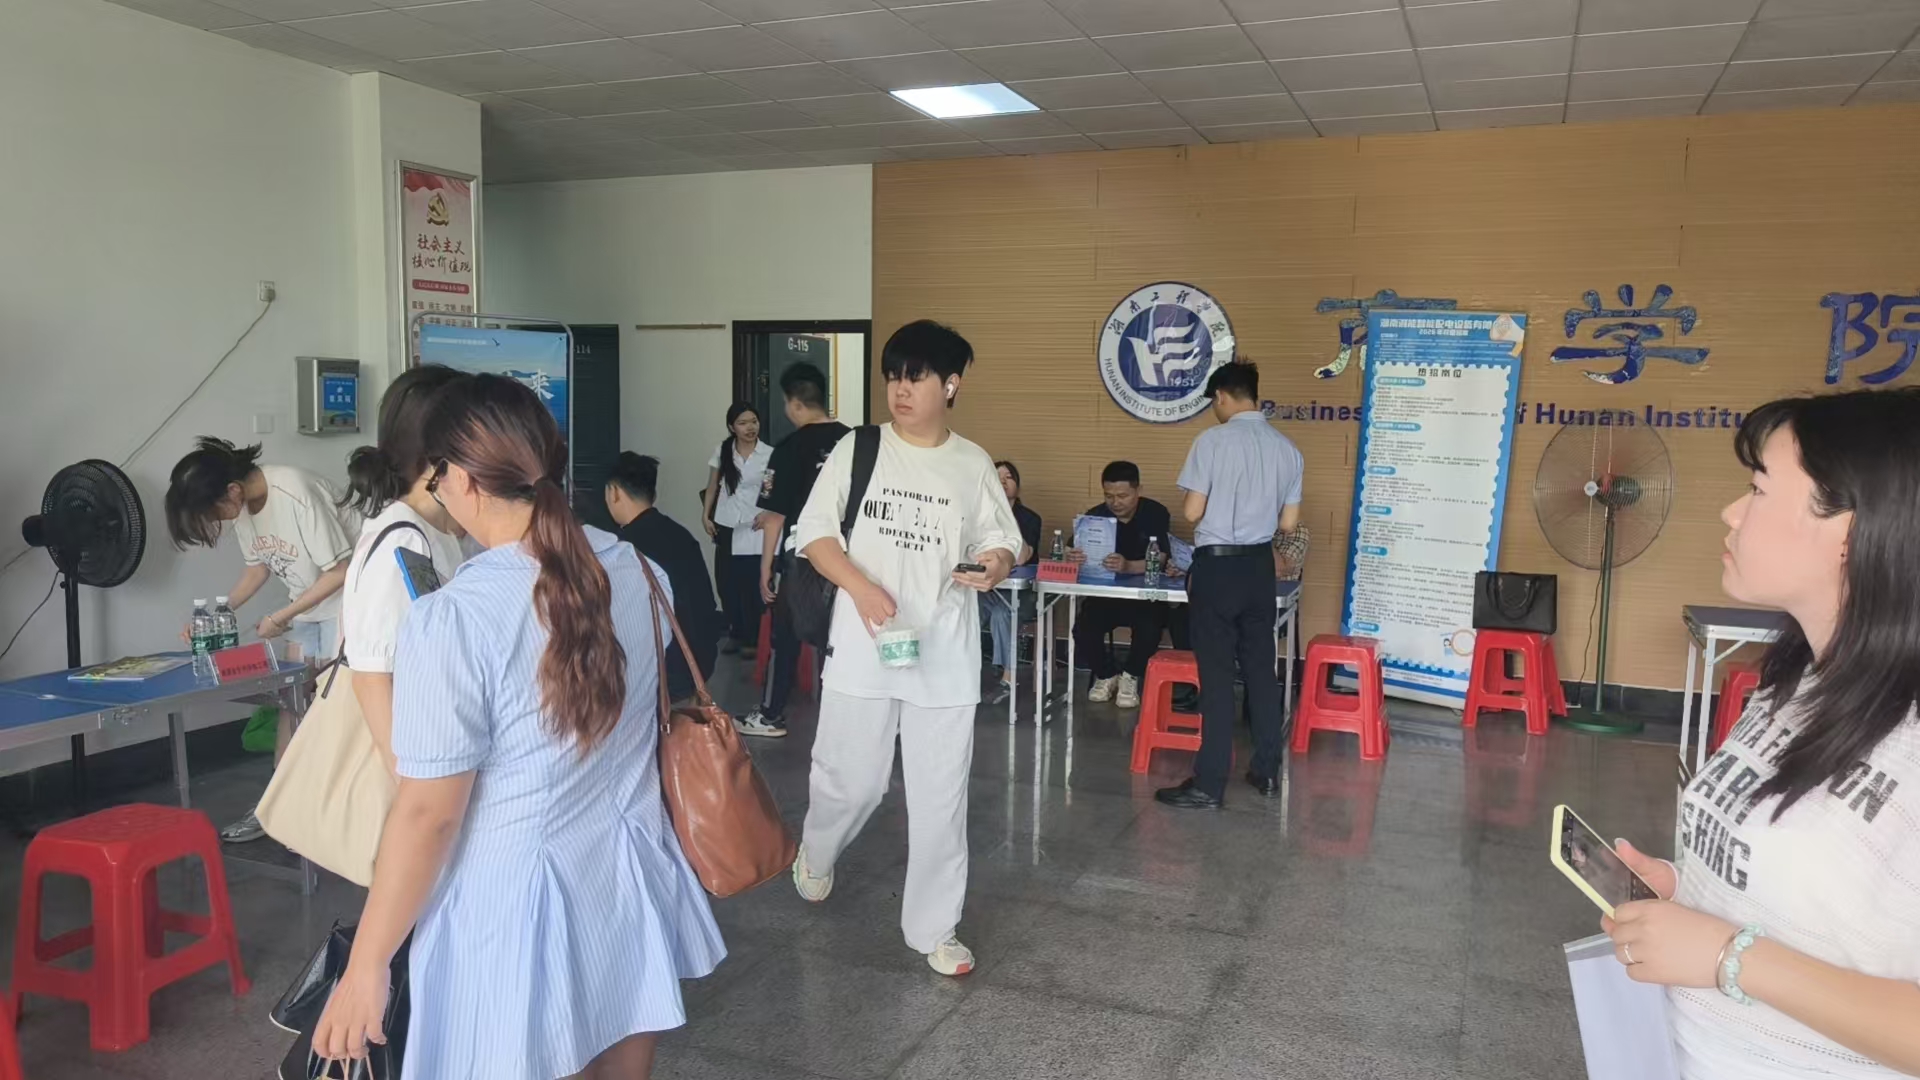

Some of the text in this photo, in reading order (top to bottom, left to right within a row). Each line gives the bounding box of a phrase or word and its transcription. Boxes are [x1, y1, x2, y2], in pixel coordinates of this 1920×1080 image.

[416, 233, 466, 256] 社会主义
[788, 337, 809, 352] G-115
[1103, 358, 1121, 392] HUNAN
[1118, 390, 1163, 416] INSTITUTE
[1164, 406, 1178, 416] OF
[1536, 402, 1635, 427] Hunan
[883, 488, 951, 506] PASTORAL OF
